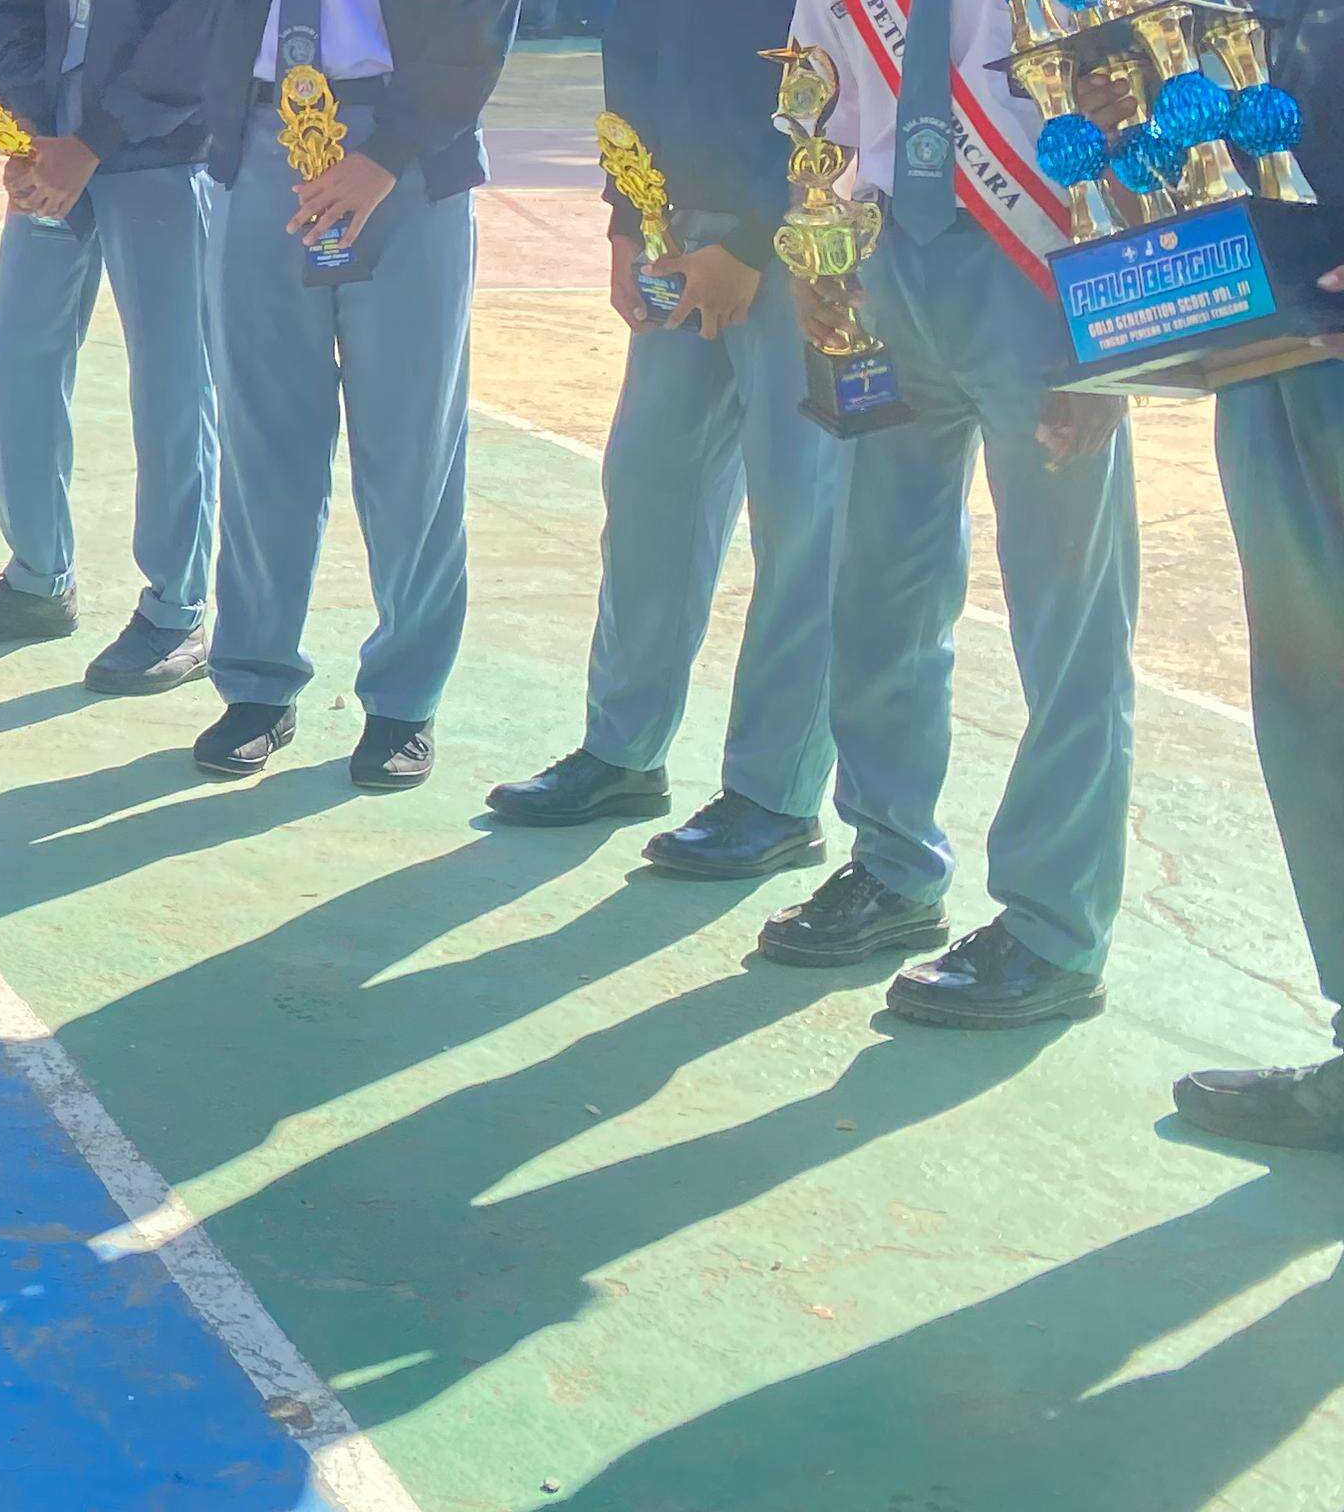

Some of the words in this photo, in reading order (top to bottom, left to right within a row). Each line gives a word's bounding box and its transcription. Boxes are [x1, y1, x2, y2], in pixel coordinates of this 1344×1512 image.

[951, 112, 1022, 211] PACARA
[1069, 266, 1143, 318] PIALA
[1140, 235, 1253, 299] BERGILIR
[1088, 318, 1114, 338] GOLD
[1177, 291, 1212, 313] SCOUT
